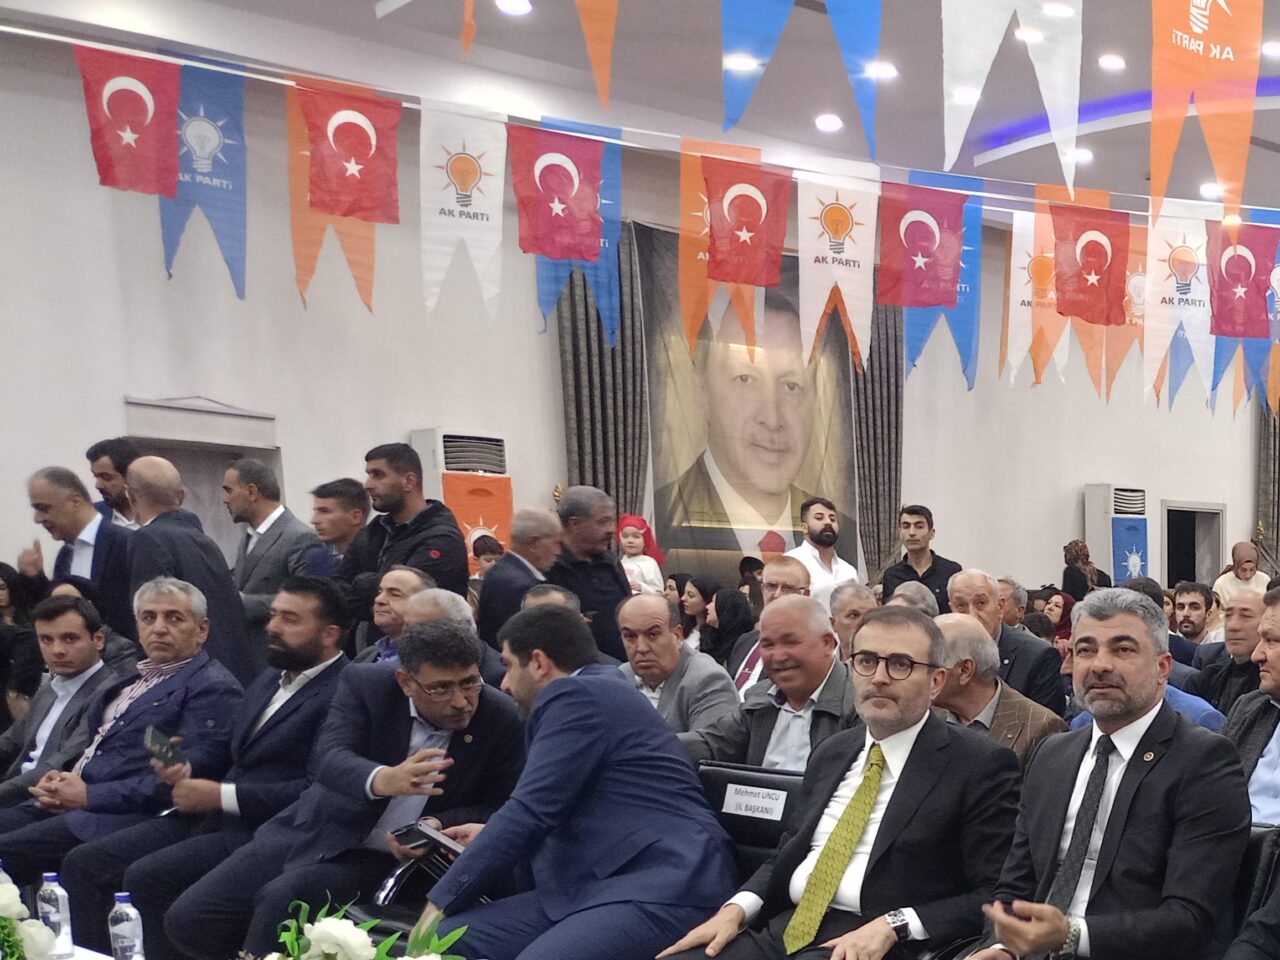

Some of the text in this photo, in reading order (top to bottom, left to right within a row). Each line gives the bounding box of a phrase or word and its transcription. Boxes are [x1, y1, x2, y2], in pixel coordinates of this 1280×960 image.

[438, 207, 456, 218] AK
[813, 255, 828, 265] AK
[1160, 296, 1175, 306] AK
